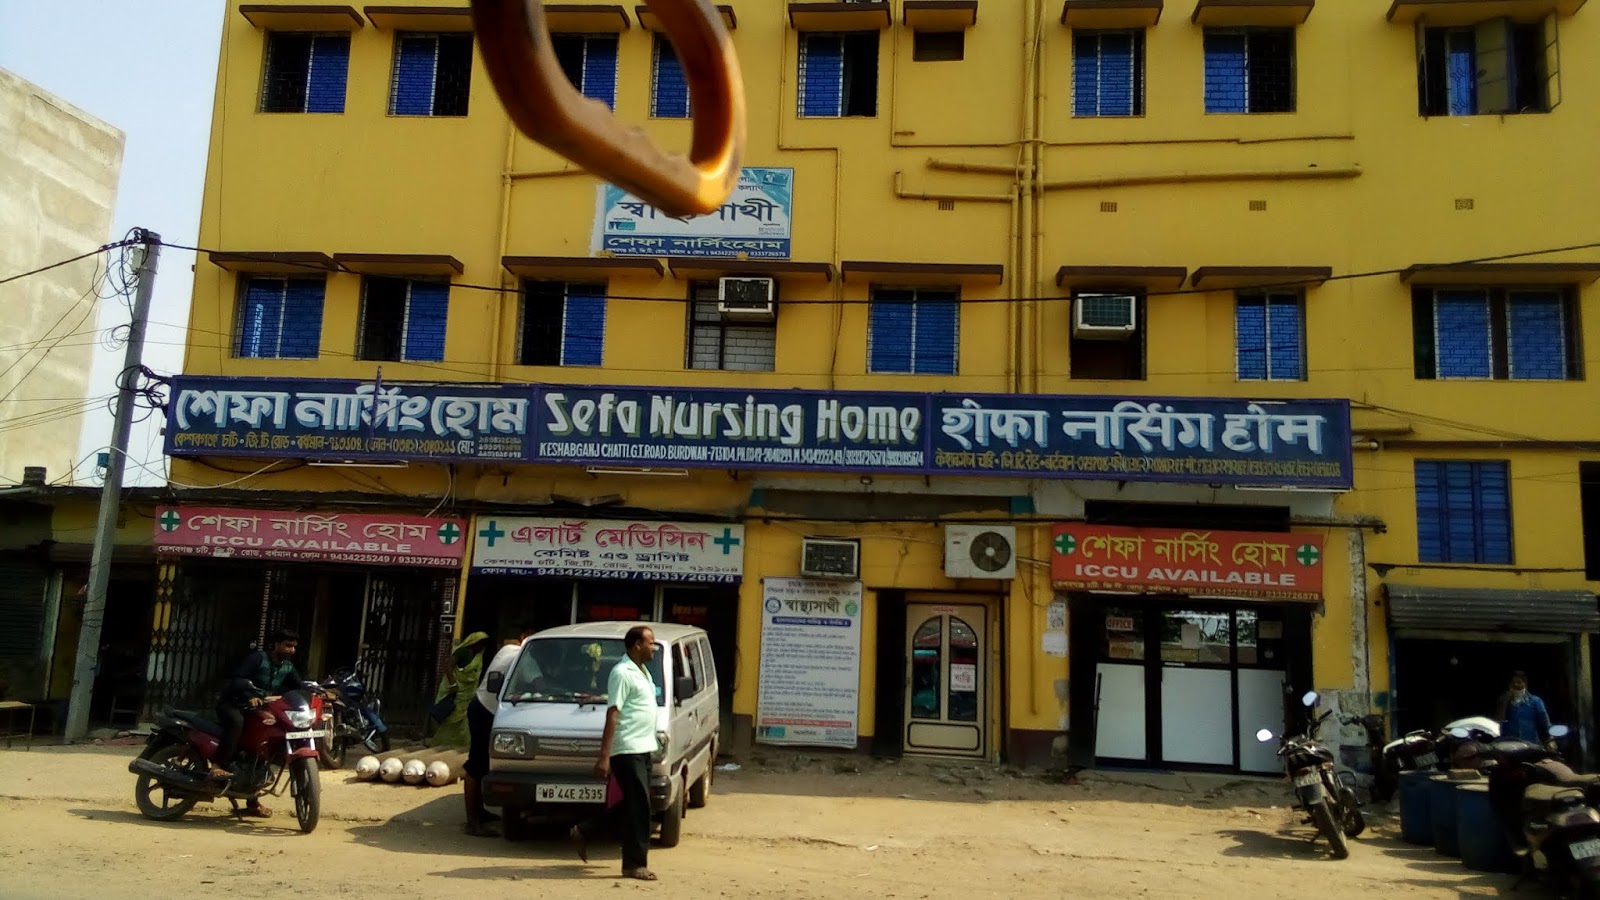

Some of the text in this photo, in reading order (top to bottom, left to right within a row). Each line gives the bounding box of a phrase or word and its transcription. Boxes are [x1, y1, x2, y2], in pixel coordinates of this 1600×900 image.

[607, 237, 665, 248] শেফা
[175, 389, 291, 431] শেফা
[544, 392, 922, 446] Sefa Nursing Home
[941, 398, 1049, 450] शेफा
[1221, 404, 1327, 454] होम
[539, 442, 600, 458] KESHABGANJ
[187, 514, 432, 542] শেফা নার্সিং হোম
[595, 523, 712, 551] মেডিসিন
[203, 535, 412, 553] ICCU AVAILABLE
[1081, 531, 1291, 569] শেফা নার্সিং হোম
[330, 553, 390, 563] 9434225249
[398, 556, 458, 566] 9333726578
[537, 567, 629, 579] 9434225249
[642, 571, 734, 583] 9333726578
[1075, 563, 1296, 586] ICCU AVAILABLE
[541, 787, 604, 800] WB 44E 2535
